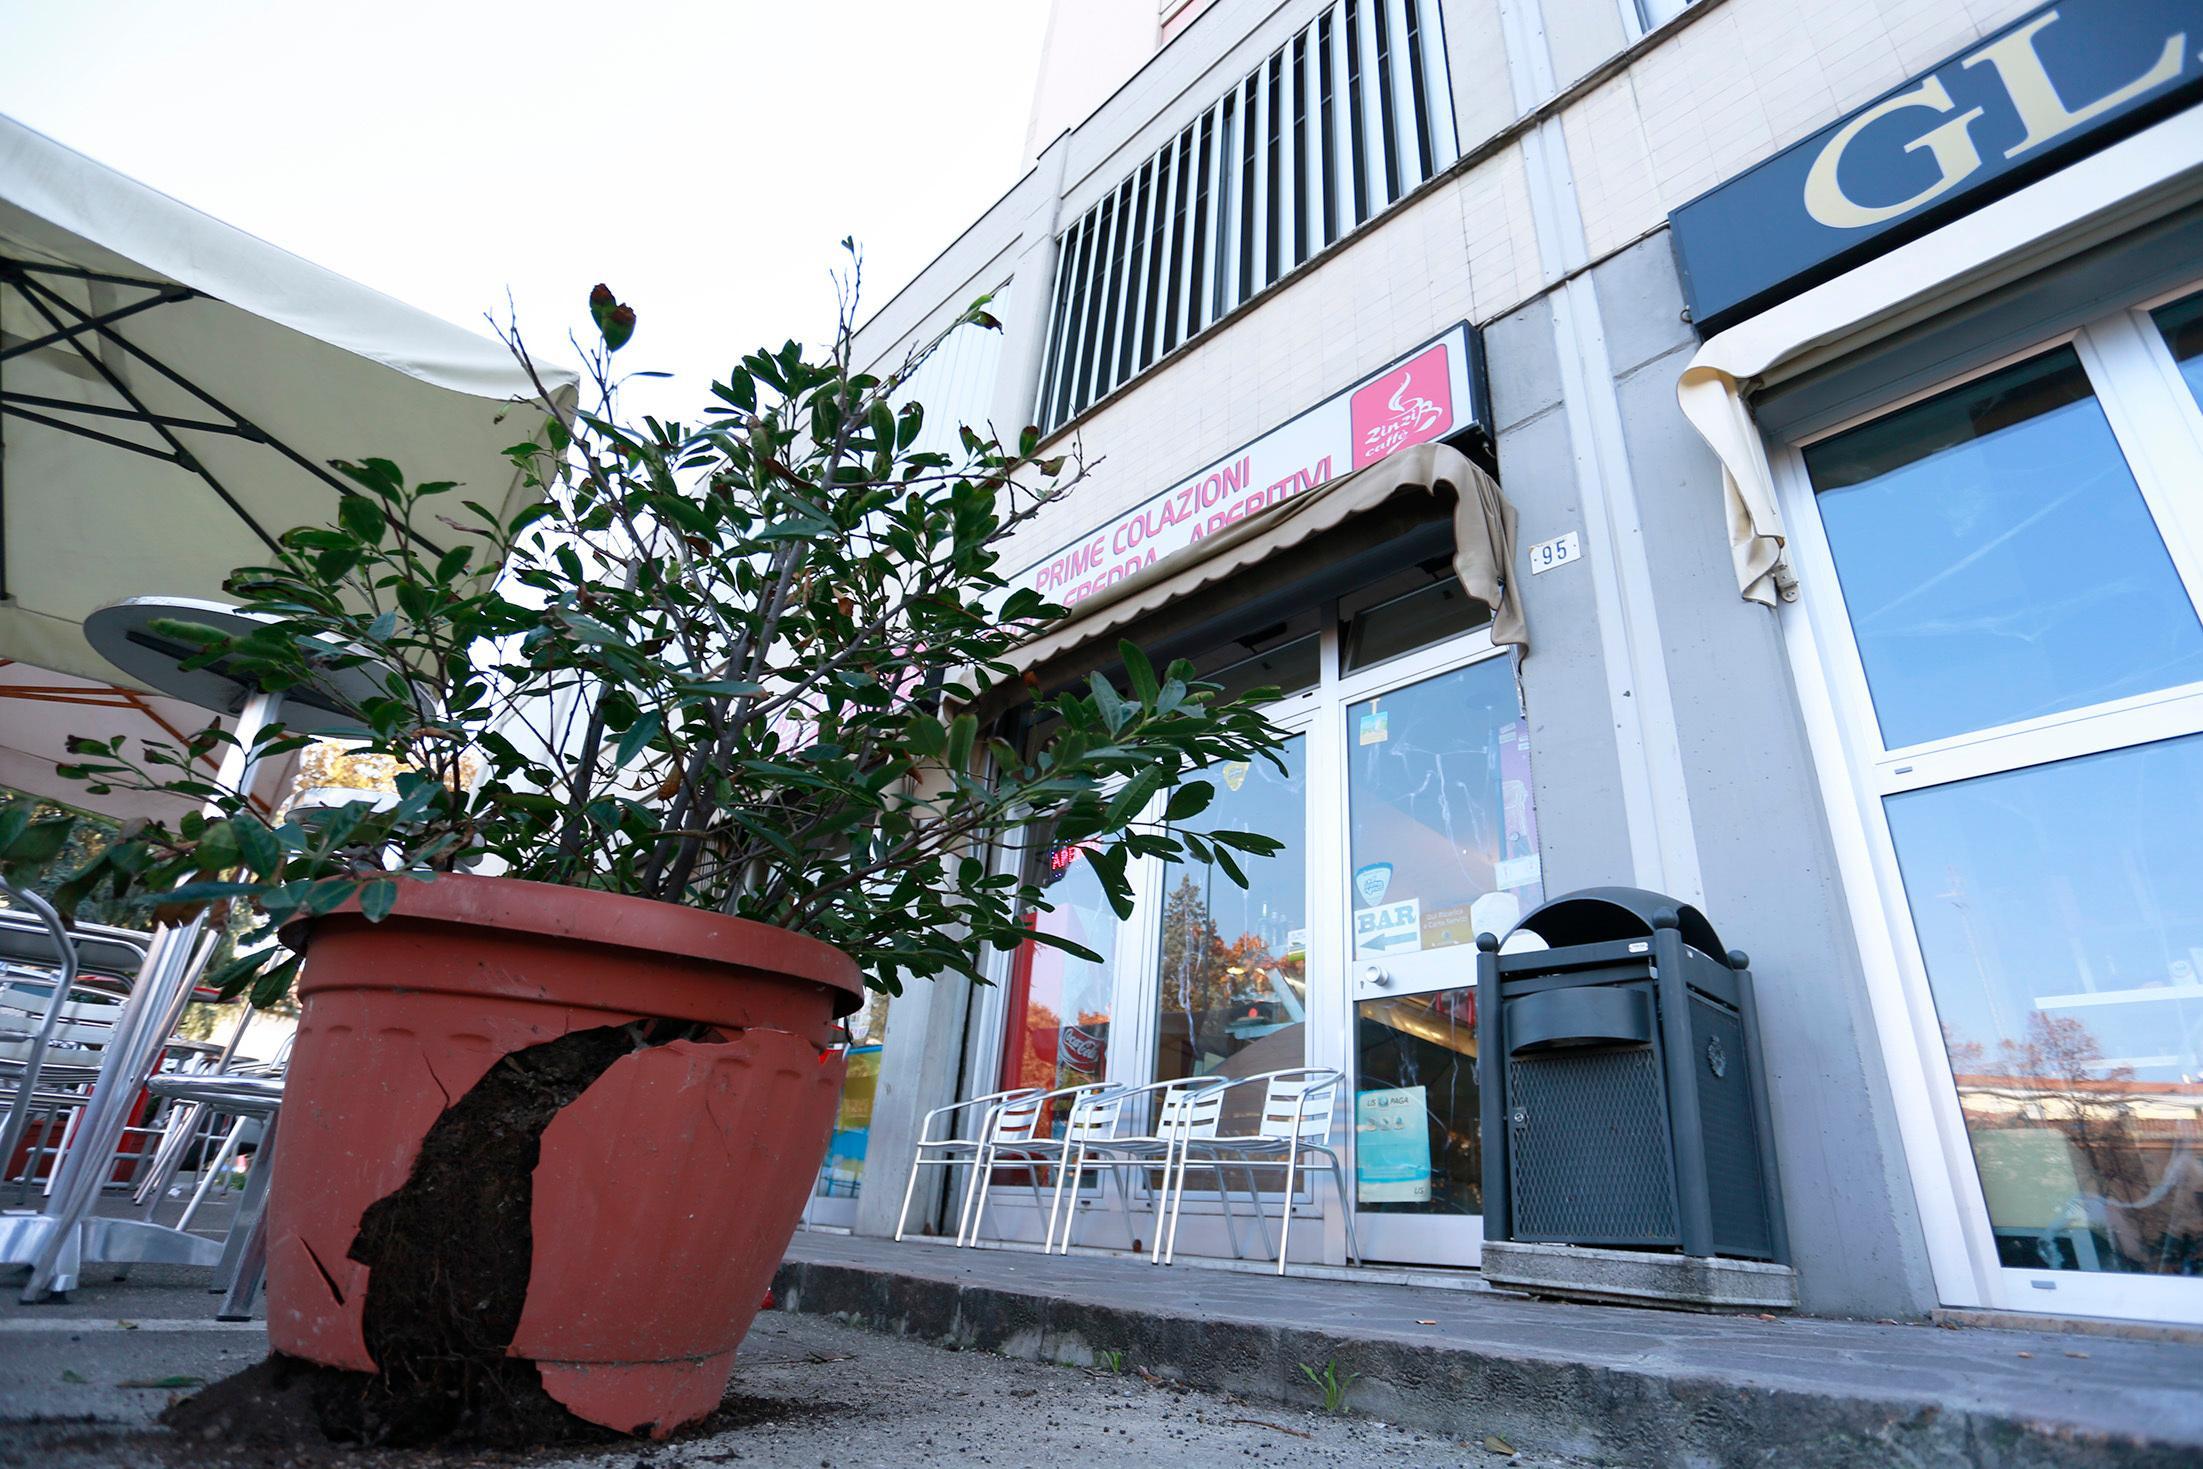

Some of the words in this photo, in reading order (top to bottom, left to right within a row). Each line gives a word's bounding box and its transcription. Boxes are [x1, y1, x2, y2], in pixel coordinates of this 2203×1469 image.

[1804, 9, 2203, 229] GL
[1035, 535, 1105, 593] PRIME
[1112, 455, 1250, 555] COLAZIONI
[1189, 454, 1333, 545] APERITIVI
[1542, 539, 1568, 566] 95
[1358, 904, 1417, 935] BAR
